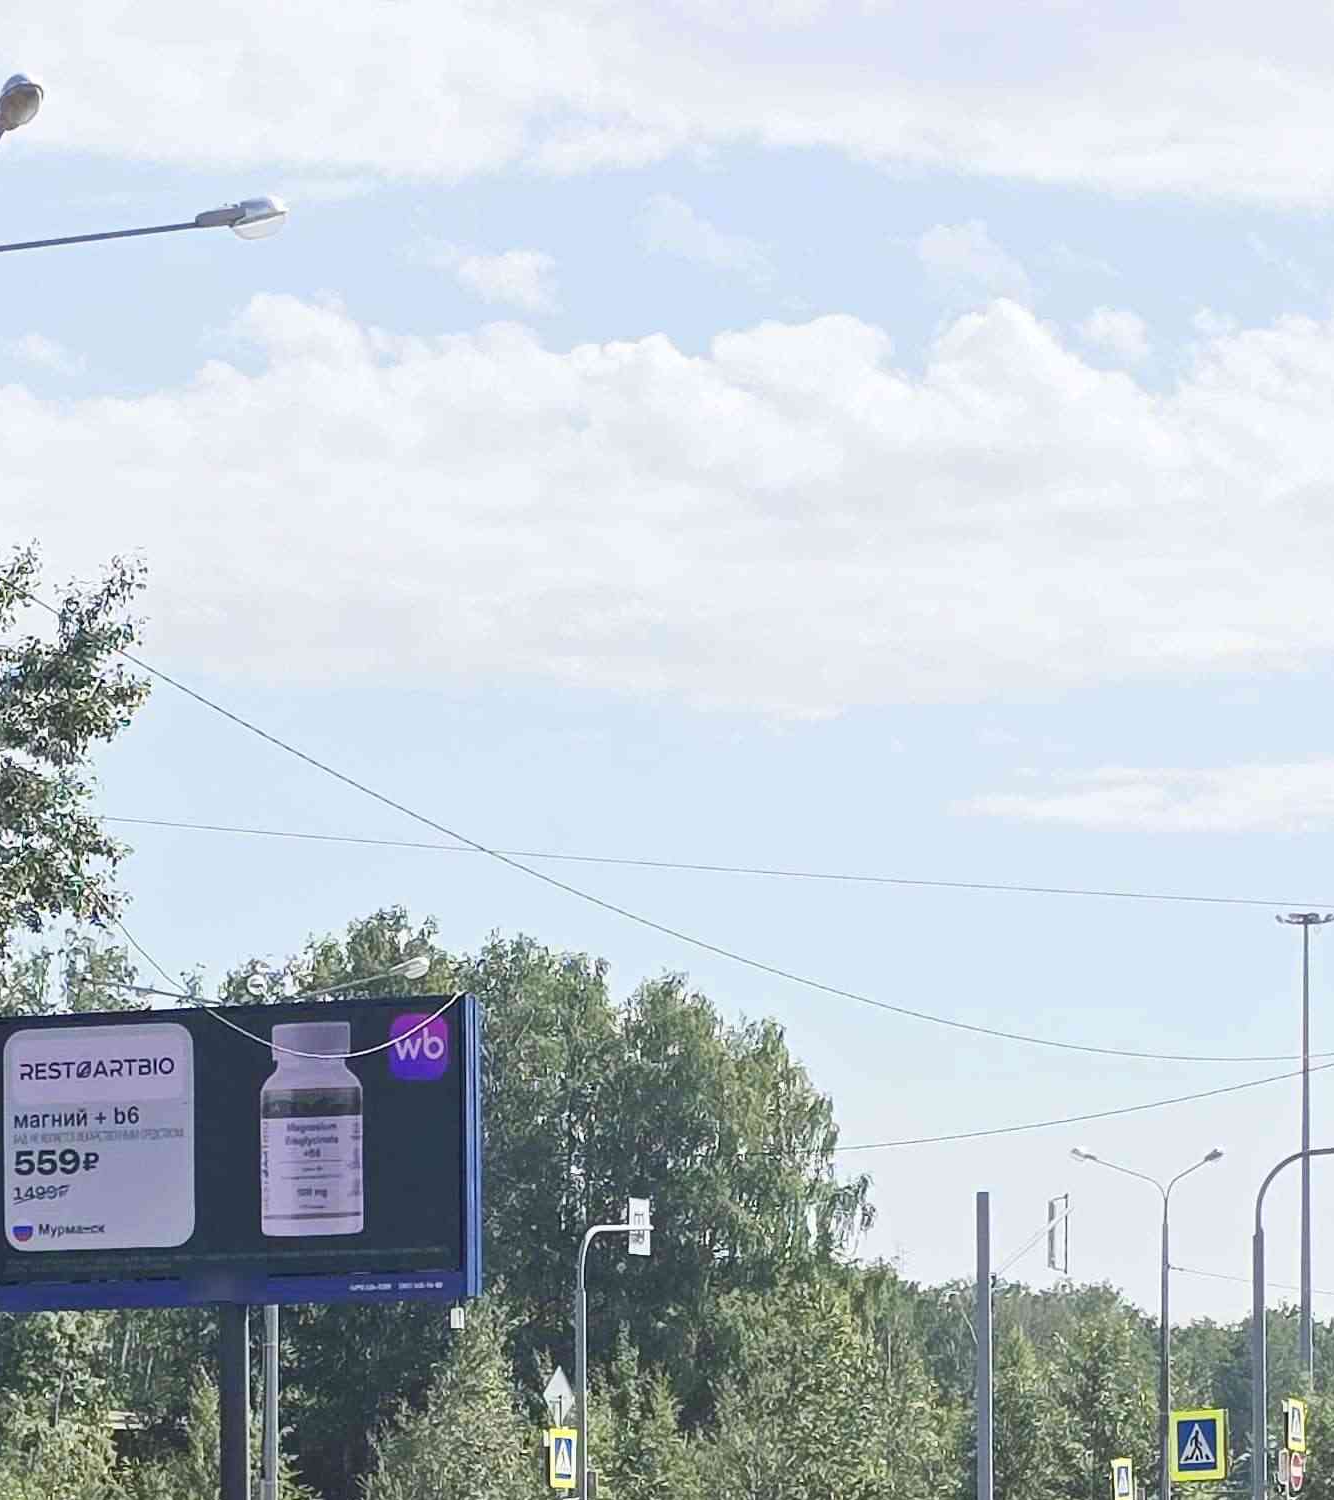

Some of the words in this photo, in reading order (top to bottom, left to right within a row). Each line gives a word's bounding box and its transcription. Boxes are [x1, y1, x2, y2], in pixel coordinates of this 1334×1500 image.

[394, 1026, 445, 1061] wb
[13, 1107, 88, 1129] магний
[95, 1111, 107, 1125] +
[114, 1106, 140, 1126] b6
